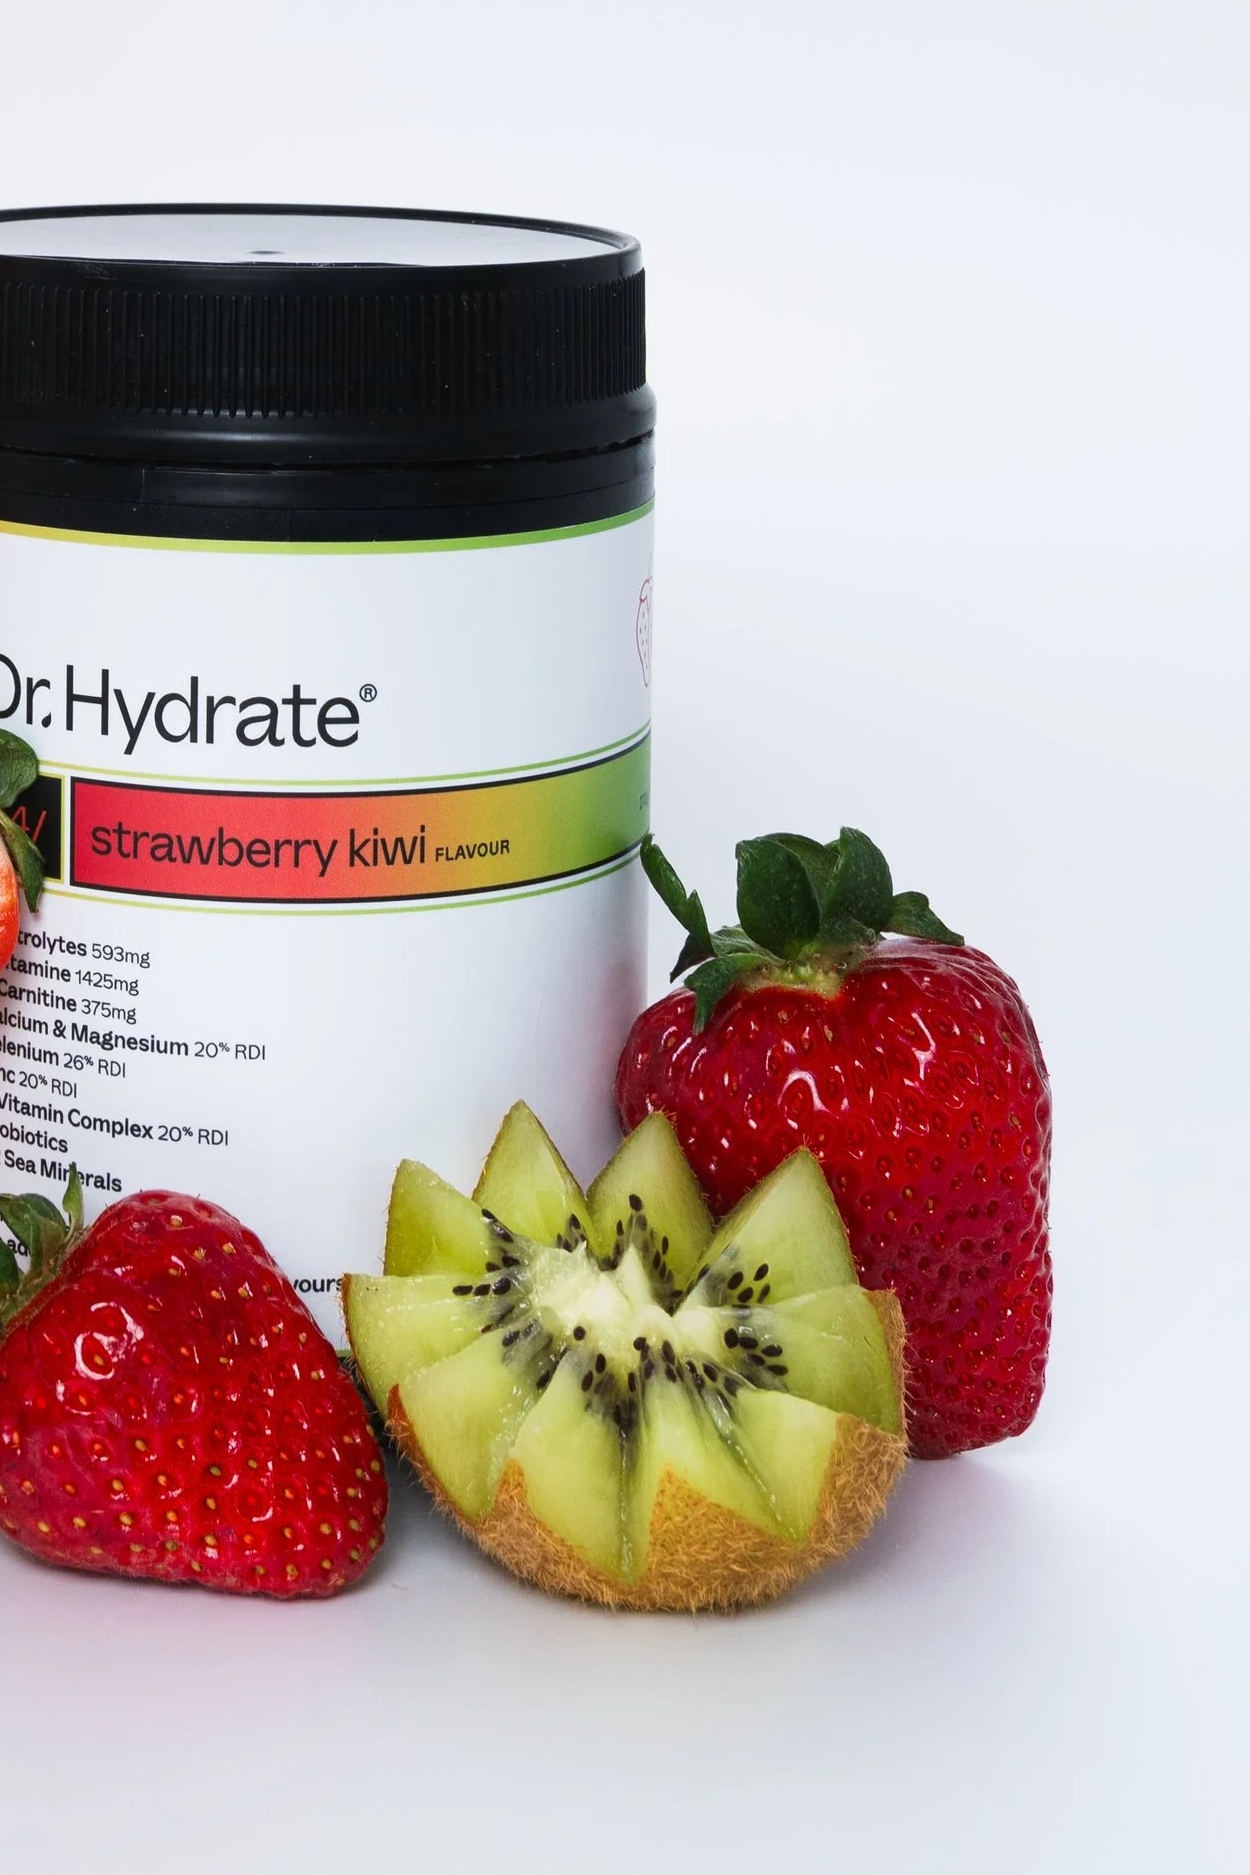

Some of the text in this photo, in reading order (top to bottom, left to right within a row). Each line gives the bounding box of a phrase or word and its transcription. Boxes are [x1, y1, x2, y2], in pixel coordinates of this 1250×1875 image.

[91, 821, 511, 877] strawberry kiwi FLAVOUR
[17, 926, 151, 969] trolytes 593mg
[5, 953, 140, 997] tamine 1425mg
[81, 998, 137, 1025] 375mg
[53, 1019, 67, 1039] &
[71, 1022, 189, 1056] Magnesium
[194, 1041, 230, 1058] 20%
[235, 1044, 266, 1060] RDI
[63, 1052, 94, 1071] 26%
[98, 1058, 126, 1078] RDI
[19, 1070, 48, 1090] 20%
[51, 1078, 77, 1099] RDI
[67, 1108, 154, 1139] Complex
[158, 1125, 194, 1142] 20%
[198, 1128, 229, 1146] RDI
[4, 1149, 37, 1175] Sea
